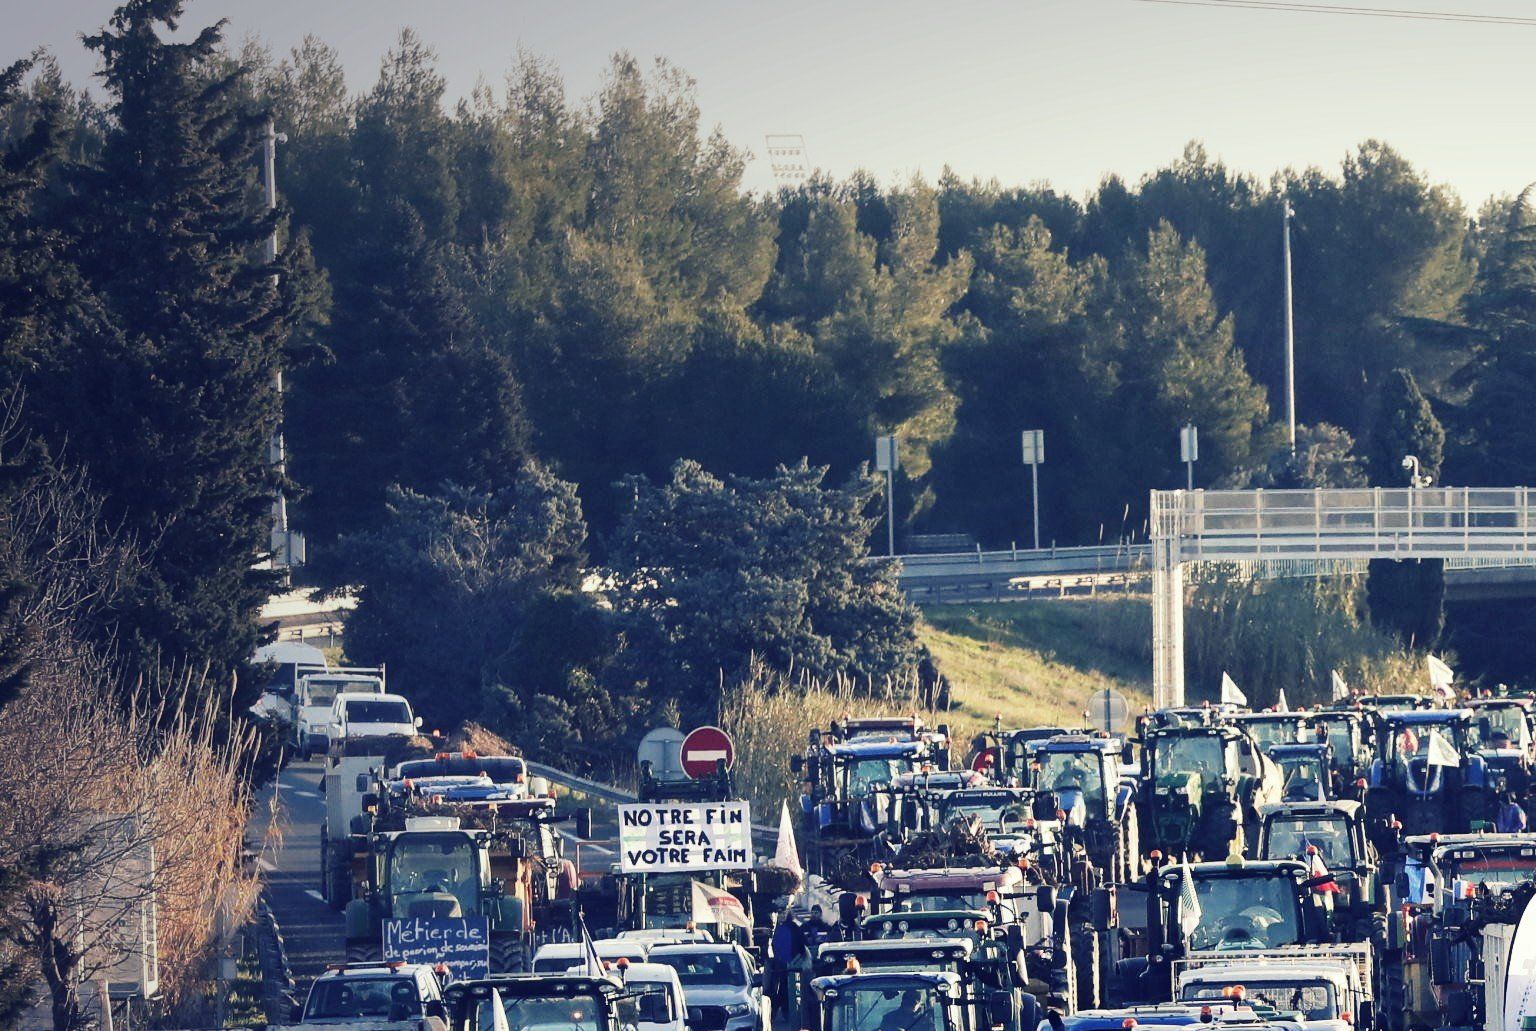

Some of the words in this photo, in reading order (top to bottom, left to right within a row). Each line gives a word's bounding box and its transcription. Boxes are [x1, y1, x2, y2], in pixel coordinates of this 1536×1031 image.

[623, 809, 694, 826] NOTRE
[659, 830, 711, 846] SERA
[627, 847, 690, 866] VOTRE
[703, 845, 747, 863] FAIM
[387, 917, 453, 945] Métier
[455, 919, 482, 940] de
